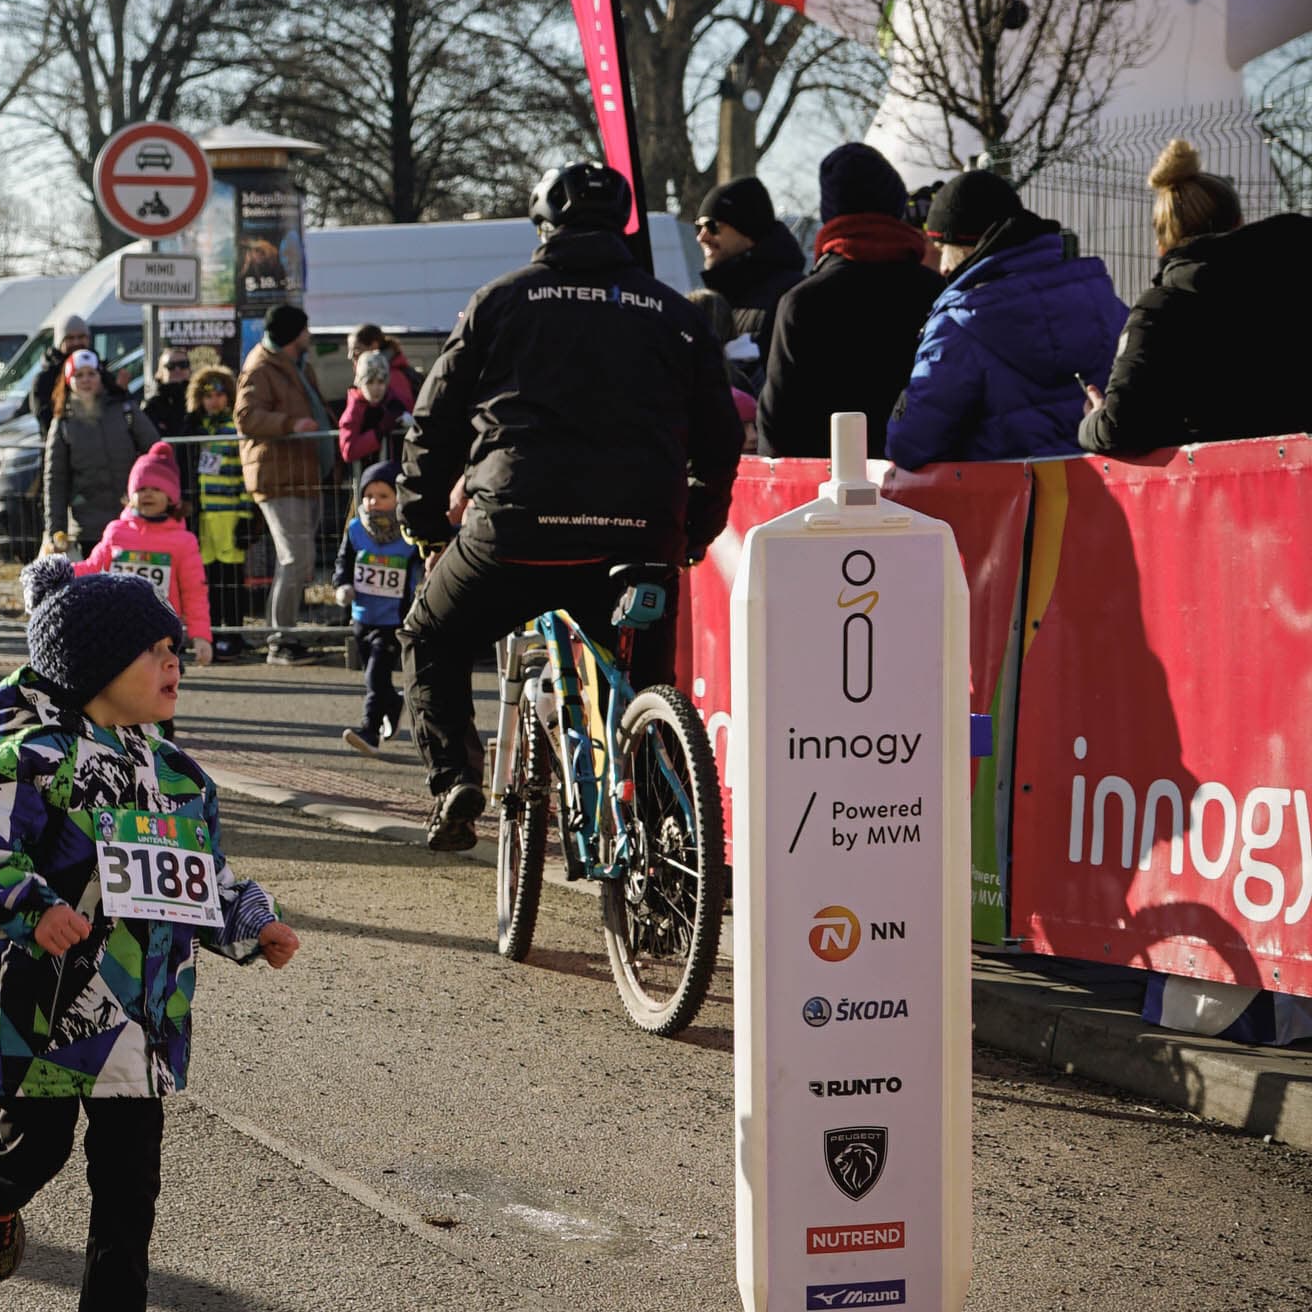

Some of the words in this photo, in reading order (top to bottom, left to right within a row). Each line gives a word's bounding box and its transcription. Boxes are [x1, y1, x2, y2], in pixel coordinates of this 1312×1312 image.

[527, 286, 607, 301] WINTER
[620, 291, 663, 313] RUN
[537, 513, 648, 528] www.winter-run.cz
[355, 565, 400, 588] 3218
[788, 727, 922, 765] innogy
[832, 796, 923, 820] Powered
[832, 826, 858, 851] by
[866, 823, 921, 845] MVM
[102, 846, 210, 903] 3188
[871, 921, 906, 941] NN
[836, 998, 909, 1022] ŠKODA
[827, 1076, 903, 1097] RUNTO
[830, 1132, 882, 1143] PEUGEOT
[812, 1227, 901, 1249] NUTREND
